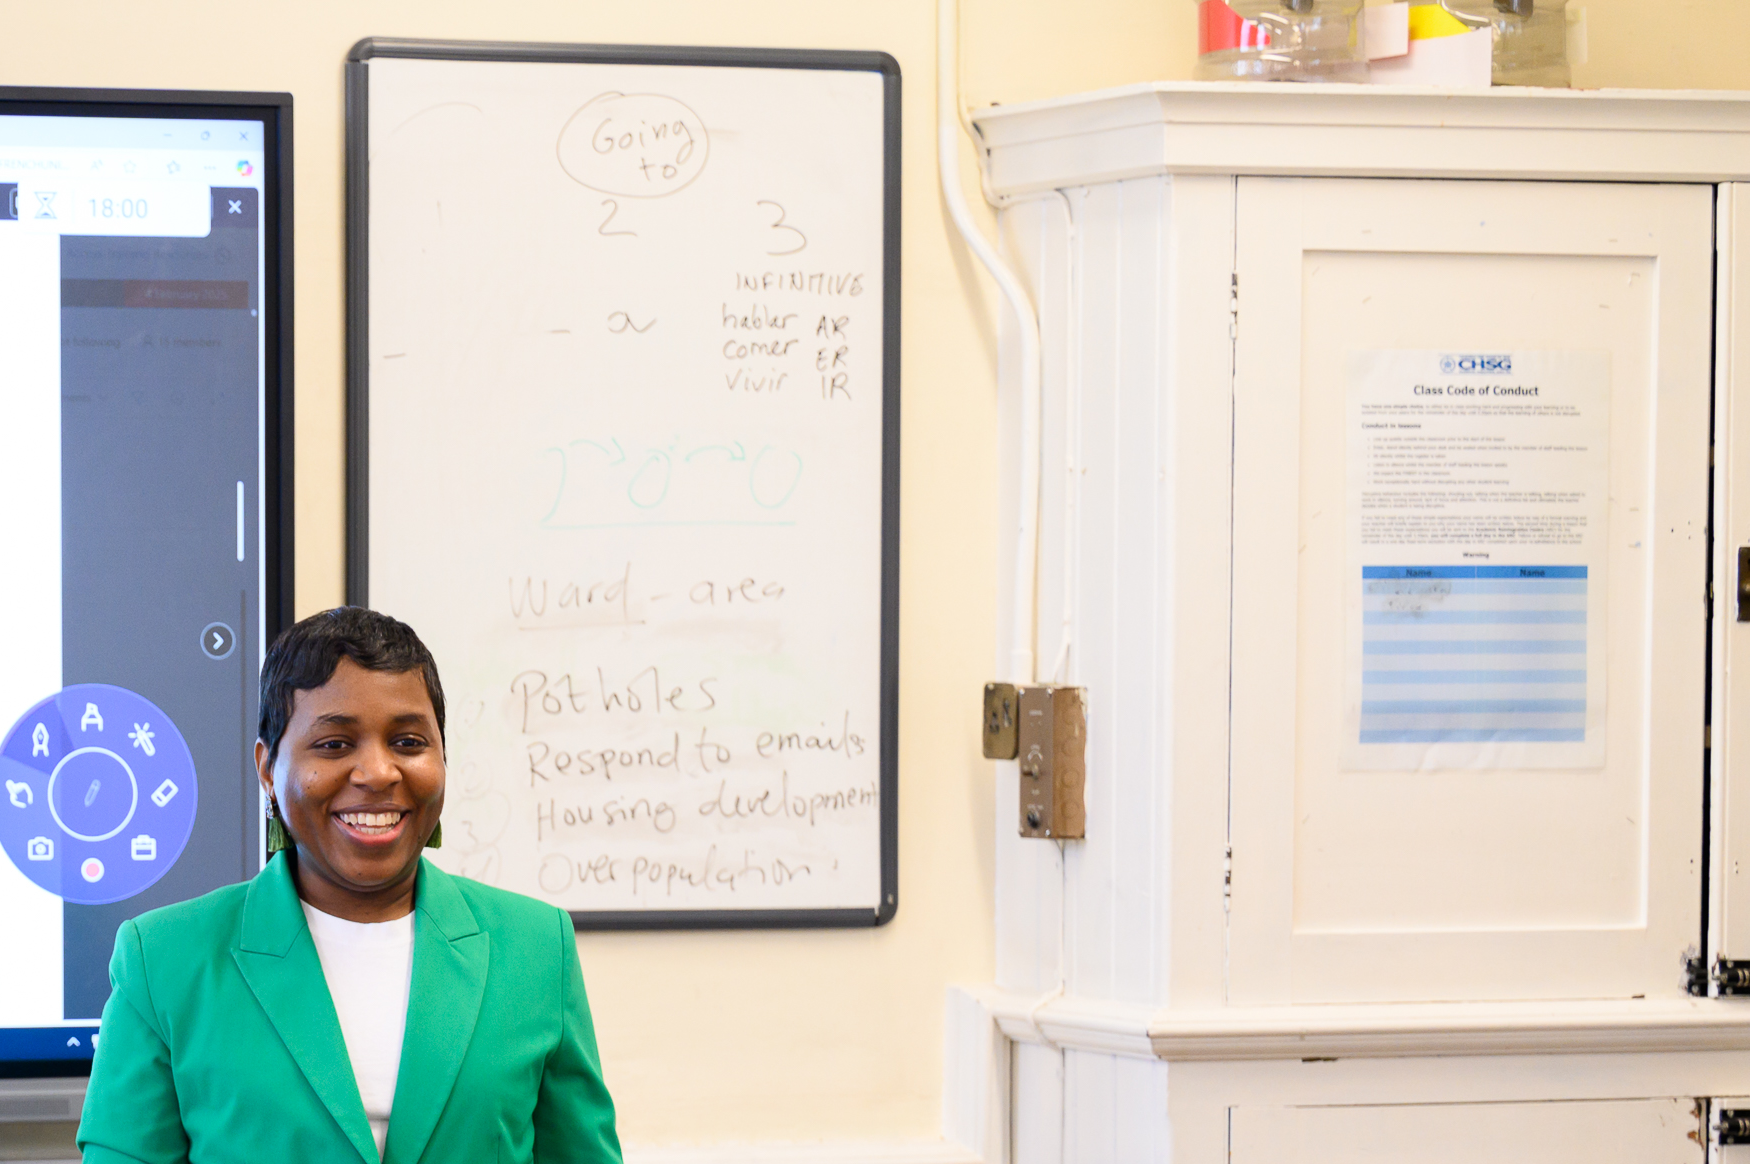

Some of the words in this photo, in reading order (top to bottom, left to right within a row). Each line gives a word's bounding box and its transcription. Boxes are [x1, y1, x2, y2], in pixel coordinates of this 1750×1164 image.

[591, 116, 696, 165] Going
[638, 155, 679, 181] to
[88, 197, 149, 219] 18:00
[597, 197, 639, 237] 2
[756, 199, 809, 256] 3
[722, 301, 800, 331] hablar
[816, 314, 851, 341] AR
[815, 345, 850, 372] ER
[1457, 357, 1513, 372] CHSG
[821, 370, 854, 402] IR
[1413, 384, 1444, 397] Class
[1446, 384, 1476, 397] Code
[1479, 384, 1491, 397] of
[1493, 384, 1540, 398] Conduct
[508, 560, 633, 622] Ward
[687, 576, 786, 607] area
[526, 731, 681, 787] Respond
[693, 725, 734, 774] to
[756, 708, 868, 759] emails
[537, 793, 678, 842] Housing
